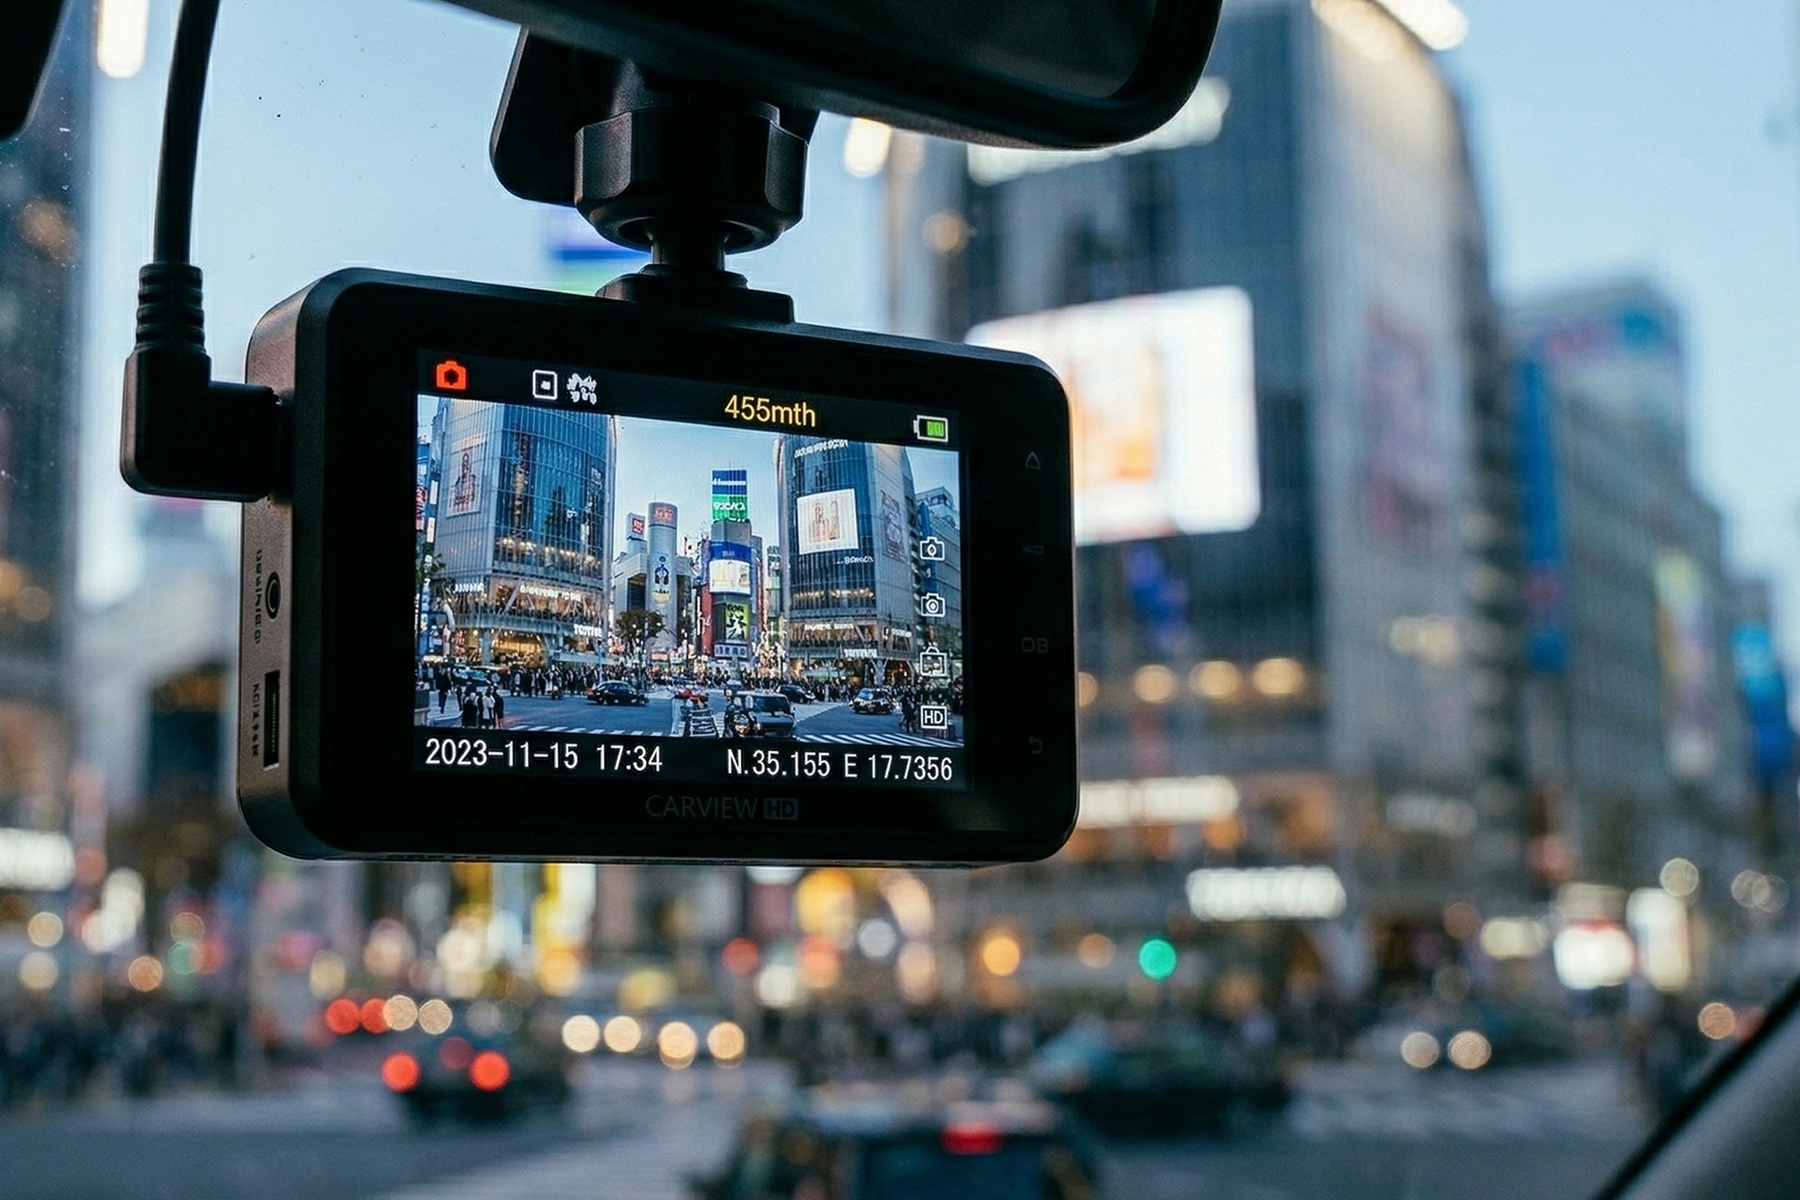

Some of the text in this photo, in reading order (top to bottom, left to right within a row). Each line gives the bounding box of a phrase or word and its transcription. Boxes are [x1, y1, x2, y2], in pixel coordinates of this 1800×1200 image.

[724, 394, 817, 429] 455mth
[924, 709, 943, 726] HD
[425, 739, 664, 773] 2023-11-15 17:34
[726, 748, 954, 782] N.35.155 E 17.7356
[645, 794, 798, 820] CARVIEW HD
